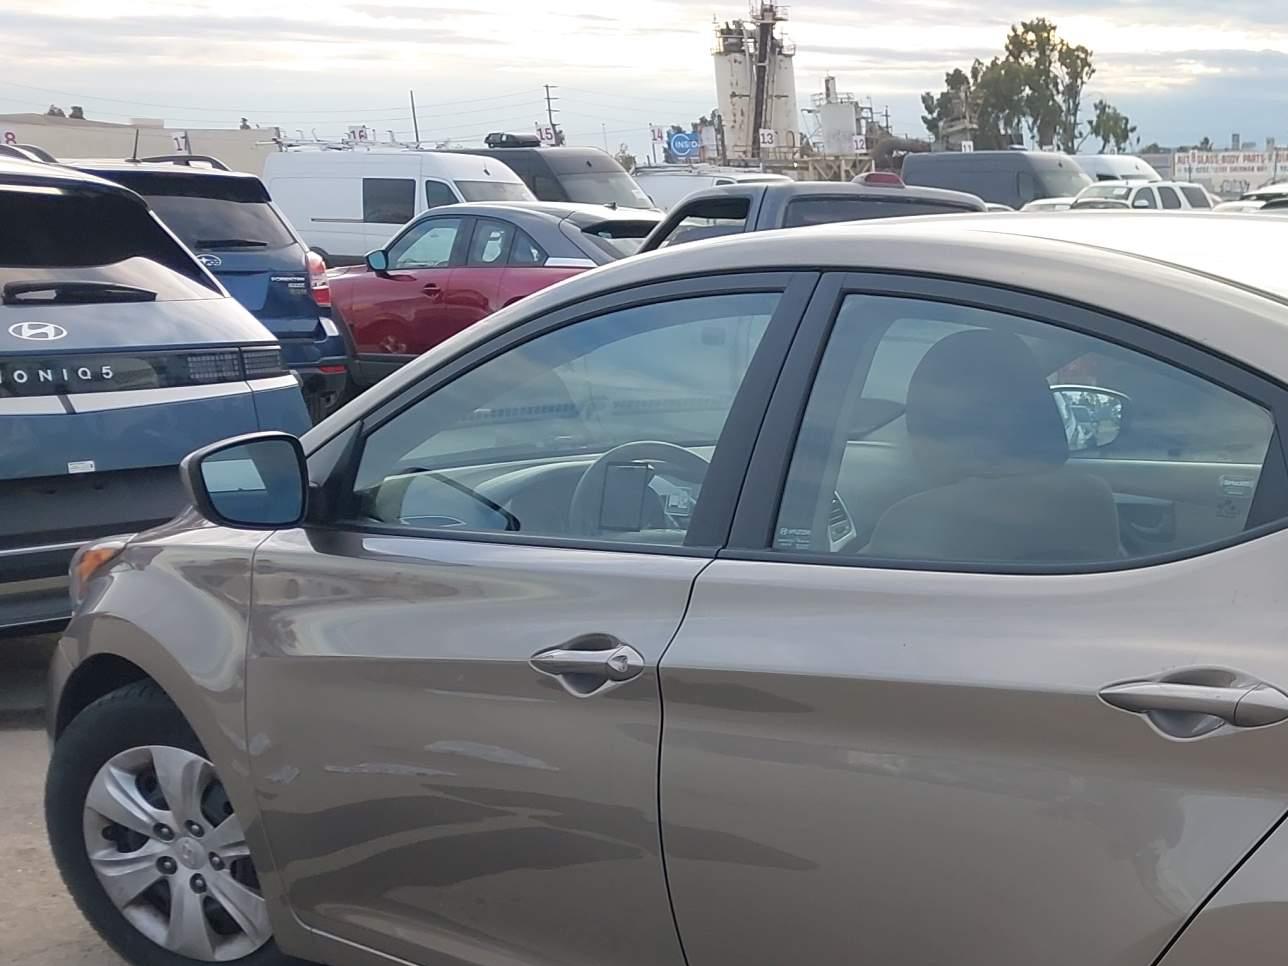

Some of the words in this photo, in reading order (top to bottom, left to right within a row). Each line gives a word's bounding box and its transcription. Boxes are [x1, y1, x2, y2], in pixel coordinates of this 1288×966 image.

[536, 127, 553, 140] 15
[651, 128, 664, 141] 14
[761, 133, 774, 144] 13
[854, 139, 865, 150] 12
